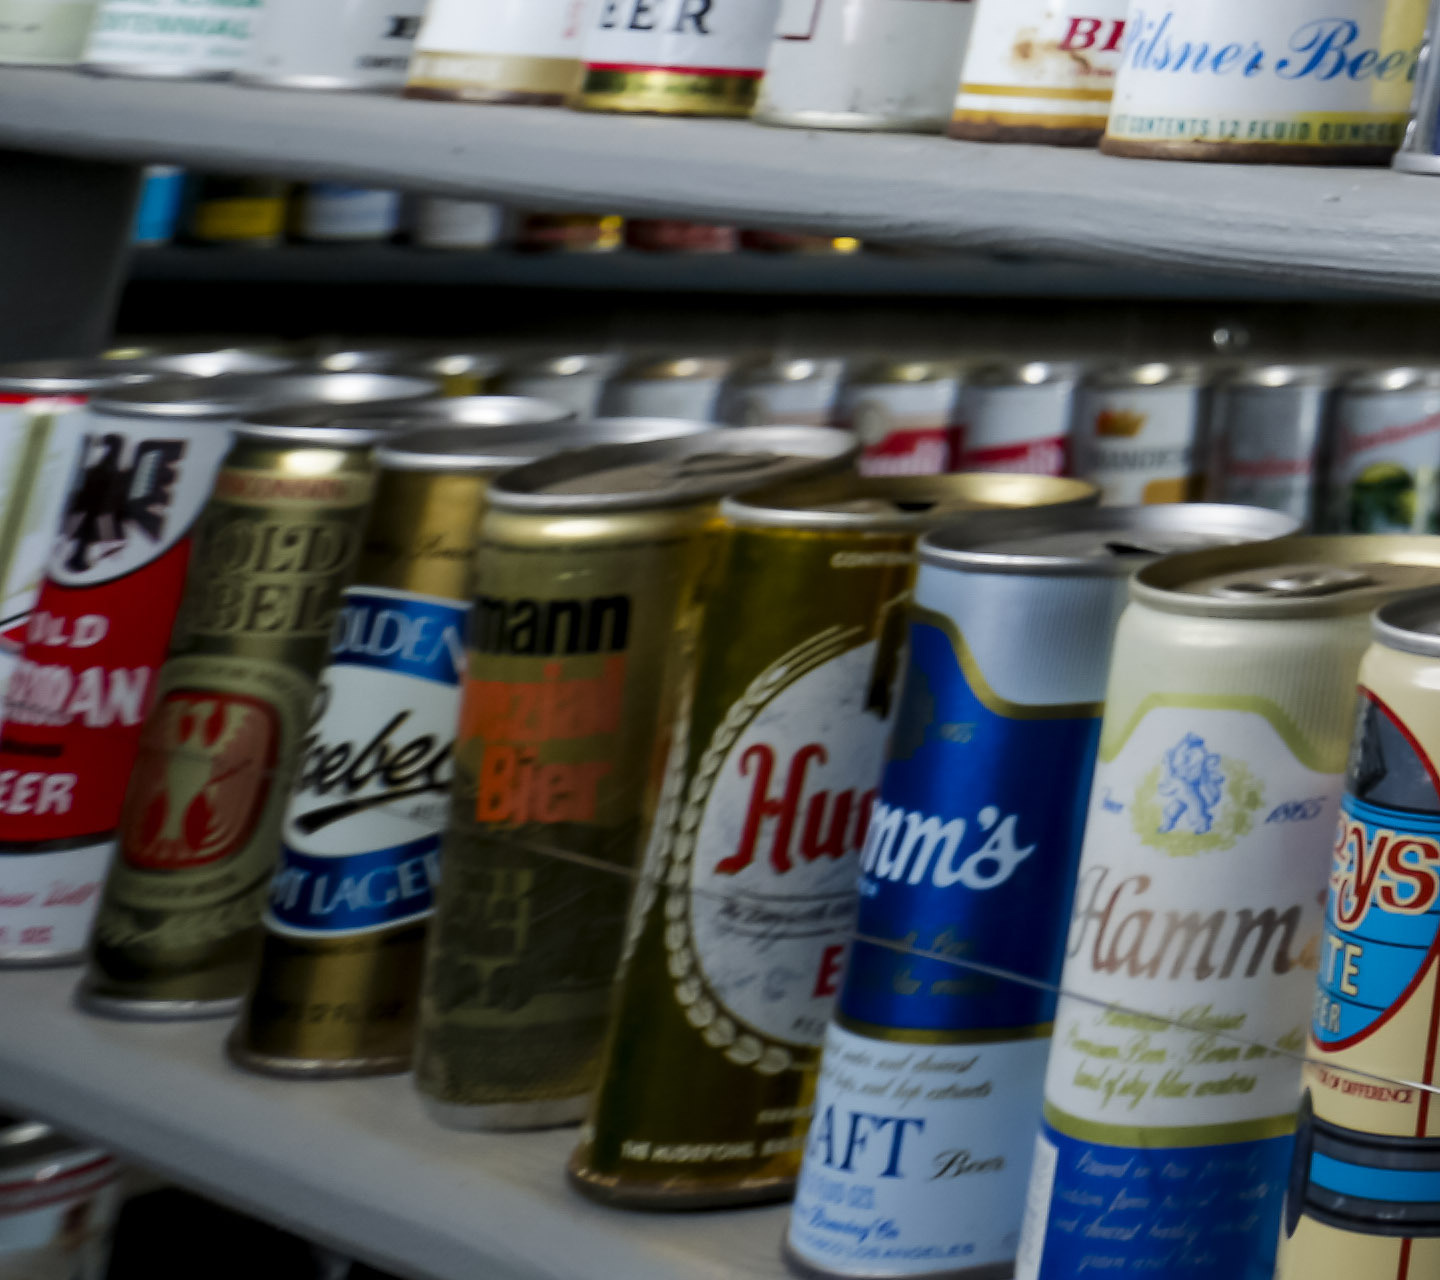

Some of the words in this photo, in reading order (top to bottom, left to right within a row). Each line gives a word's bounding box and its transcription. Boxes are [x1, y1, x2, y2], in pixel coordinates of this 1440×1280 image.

[1276, 17, 1421, 83] Beer
[0, 770, 79, 816] EER
[862, 802, 1036, 892] mm's
[1064, 863, 1324, 982] Hamm'
[811, 1103, 925, 1179] AFT
[926, 1147, 1006, 1183] Beer
